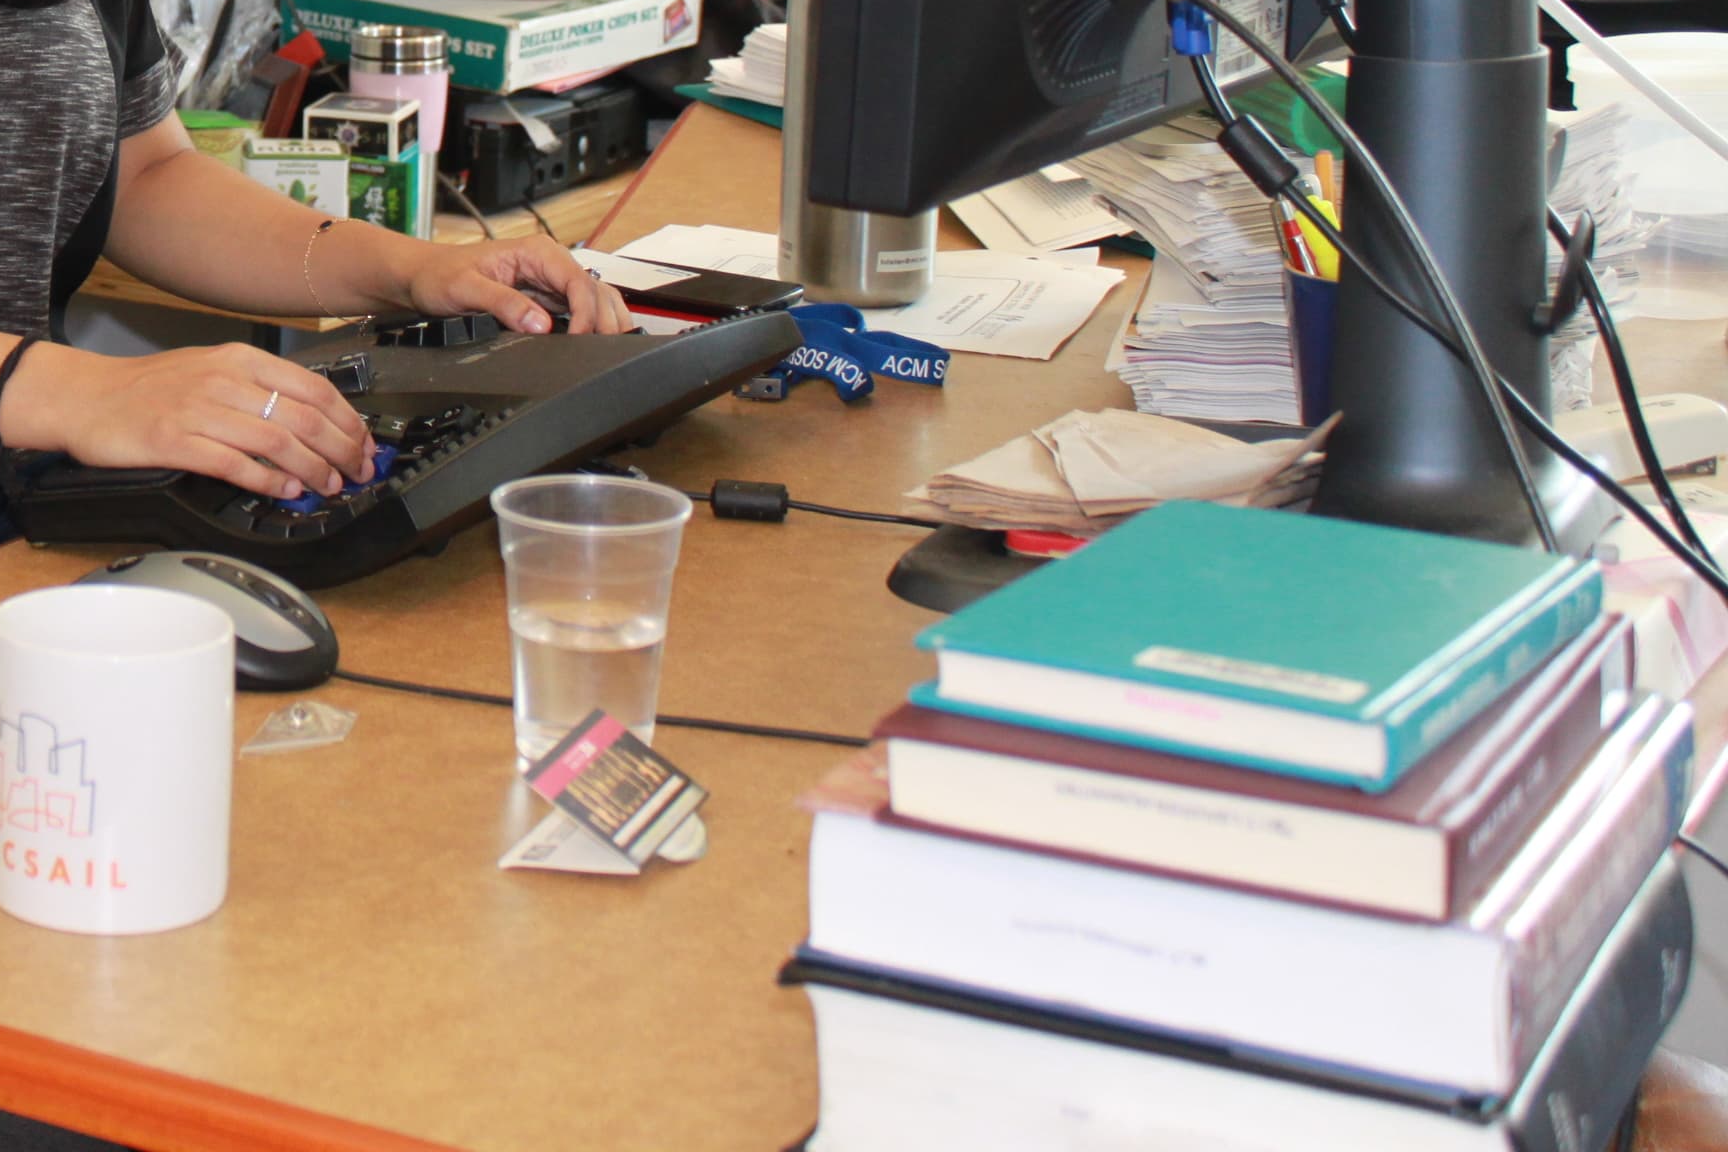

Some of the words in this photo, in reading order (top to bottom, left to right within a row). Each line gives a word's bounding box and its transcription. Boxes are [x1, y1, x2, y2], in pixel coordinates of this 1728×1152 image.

[519, 27, 565, 49] DELUXE
[567, 19, 605, 39] POKER
[640, 5, 659, 22] SET
[464, 39, 498, 60] SET
[825, 355, 867, 391] ACM
[881, 355, 929, 379] ACM
[2, 839, 129, 890] CSAIL
